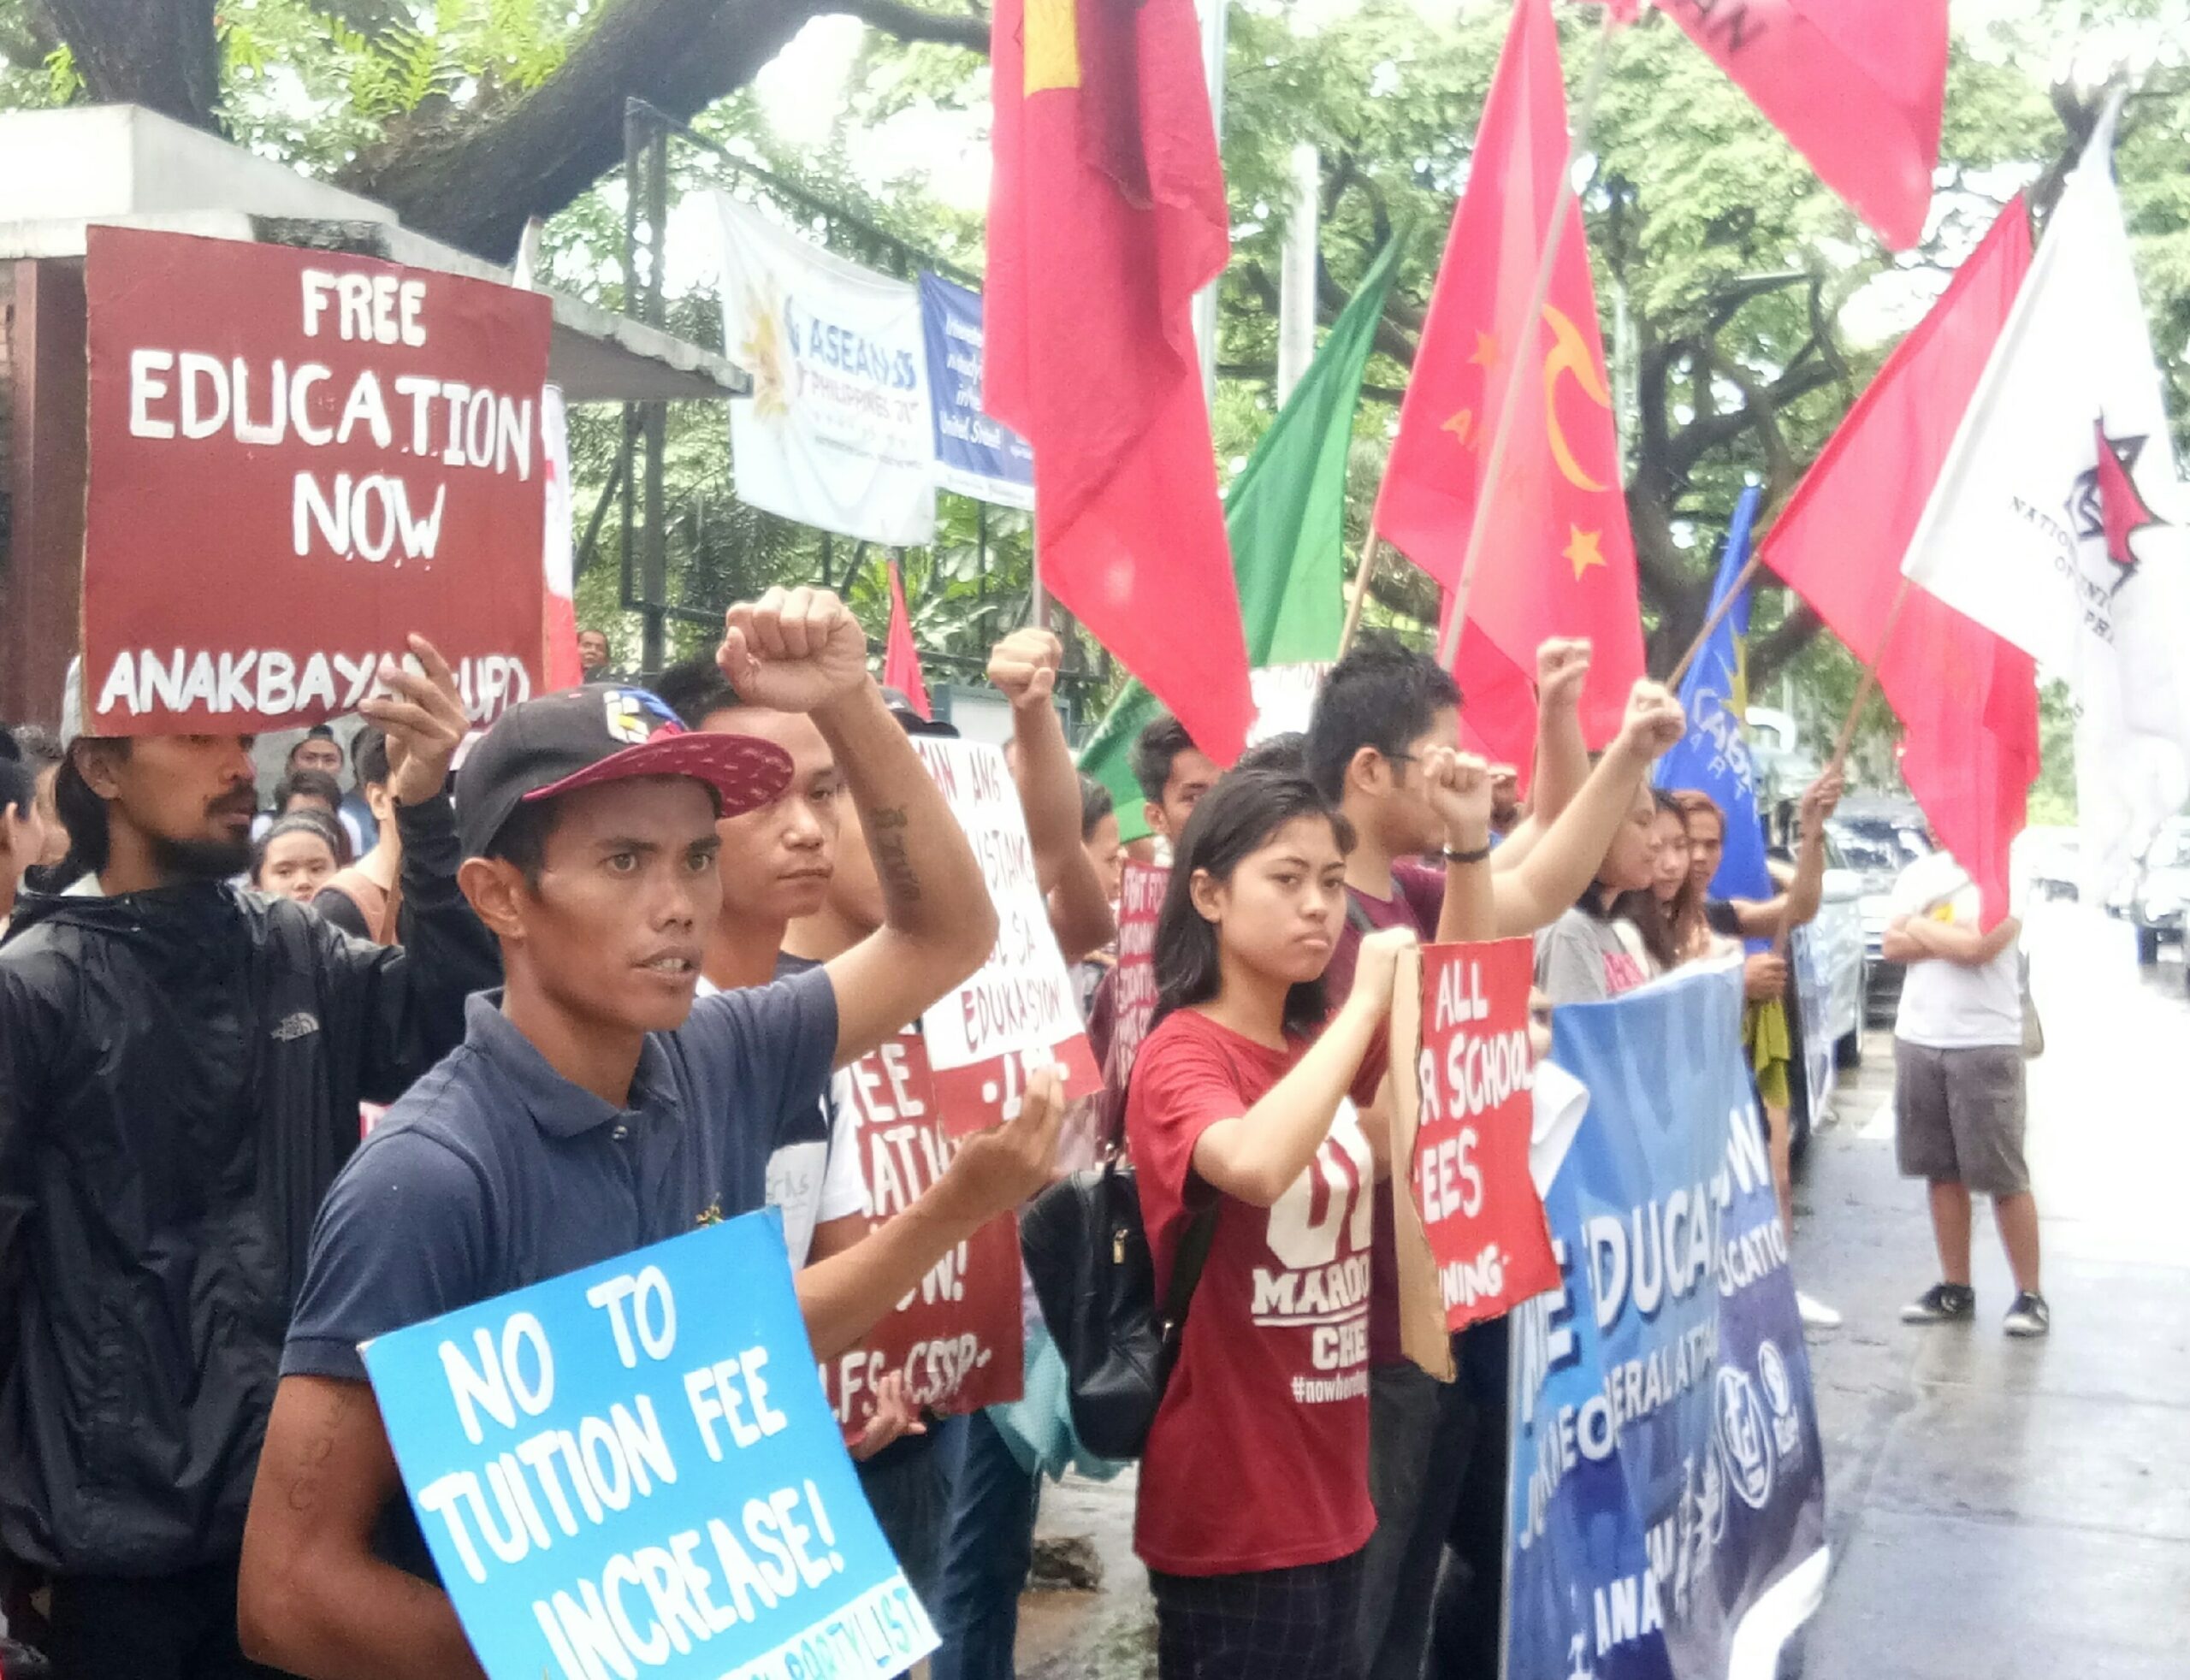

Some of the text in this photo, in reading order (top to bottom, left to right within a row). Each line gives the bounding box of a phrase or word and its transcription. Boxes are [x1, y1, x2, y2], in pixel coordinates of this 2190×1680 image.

[301, 269, 428, 347] FREE
[810, 318, 890, 386] ASEAN
[129, 349, 532, 482] EDUCATION
[292, 471, 446, 571] NOW
[1435, 958, 1489, 1033] ALL
[1447, 1029, 1535, 1120] SCHOOL
[437, 1264, 677, 1446] NO TO
[417, 1345, 789, 1584] TUITION FEE
[531, 1478, 845, 1680] INCREASE!
